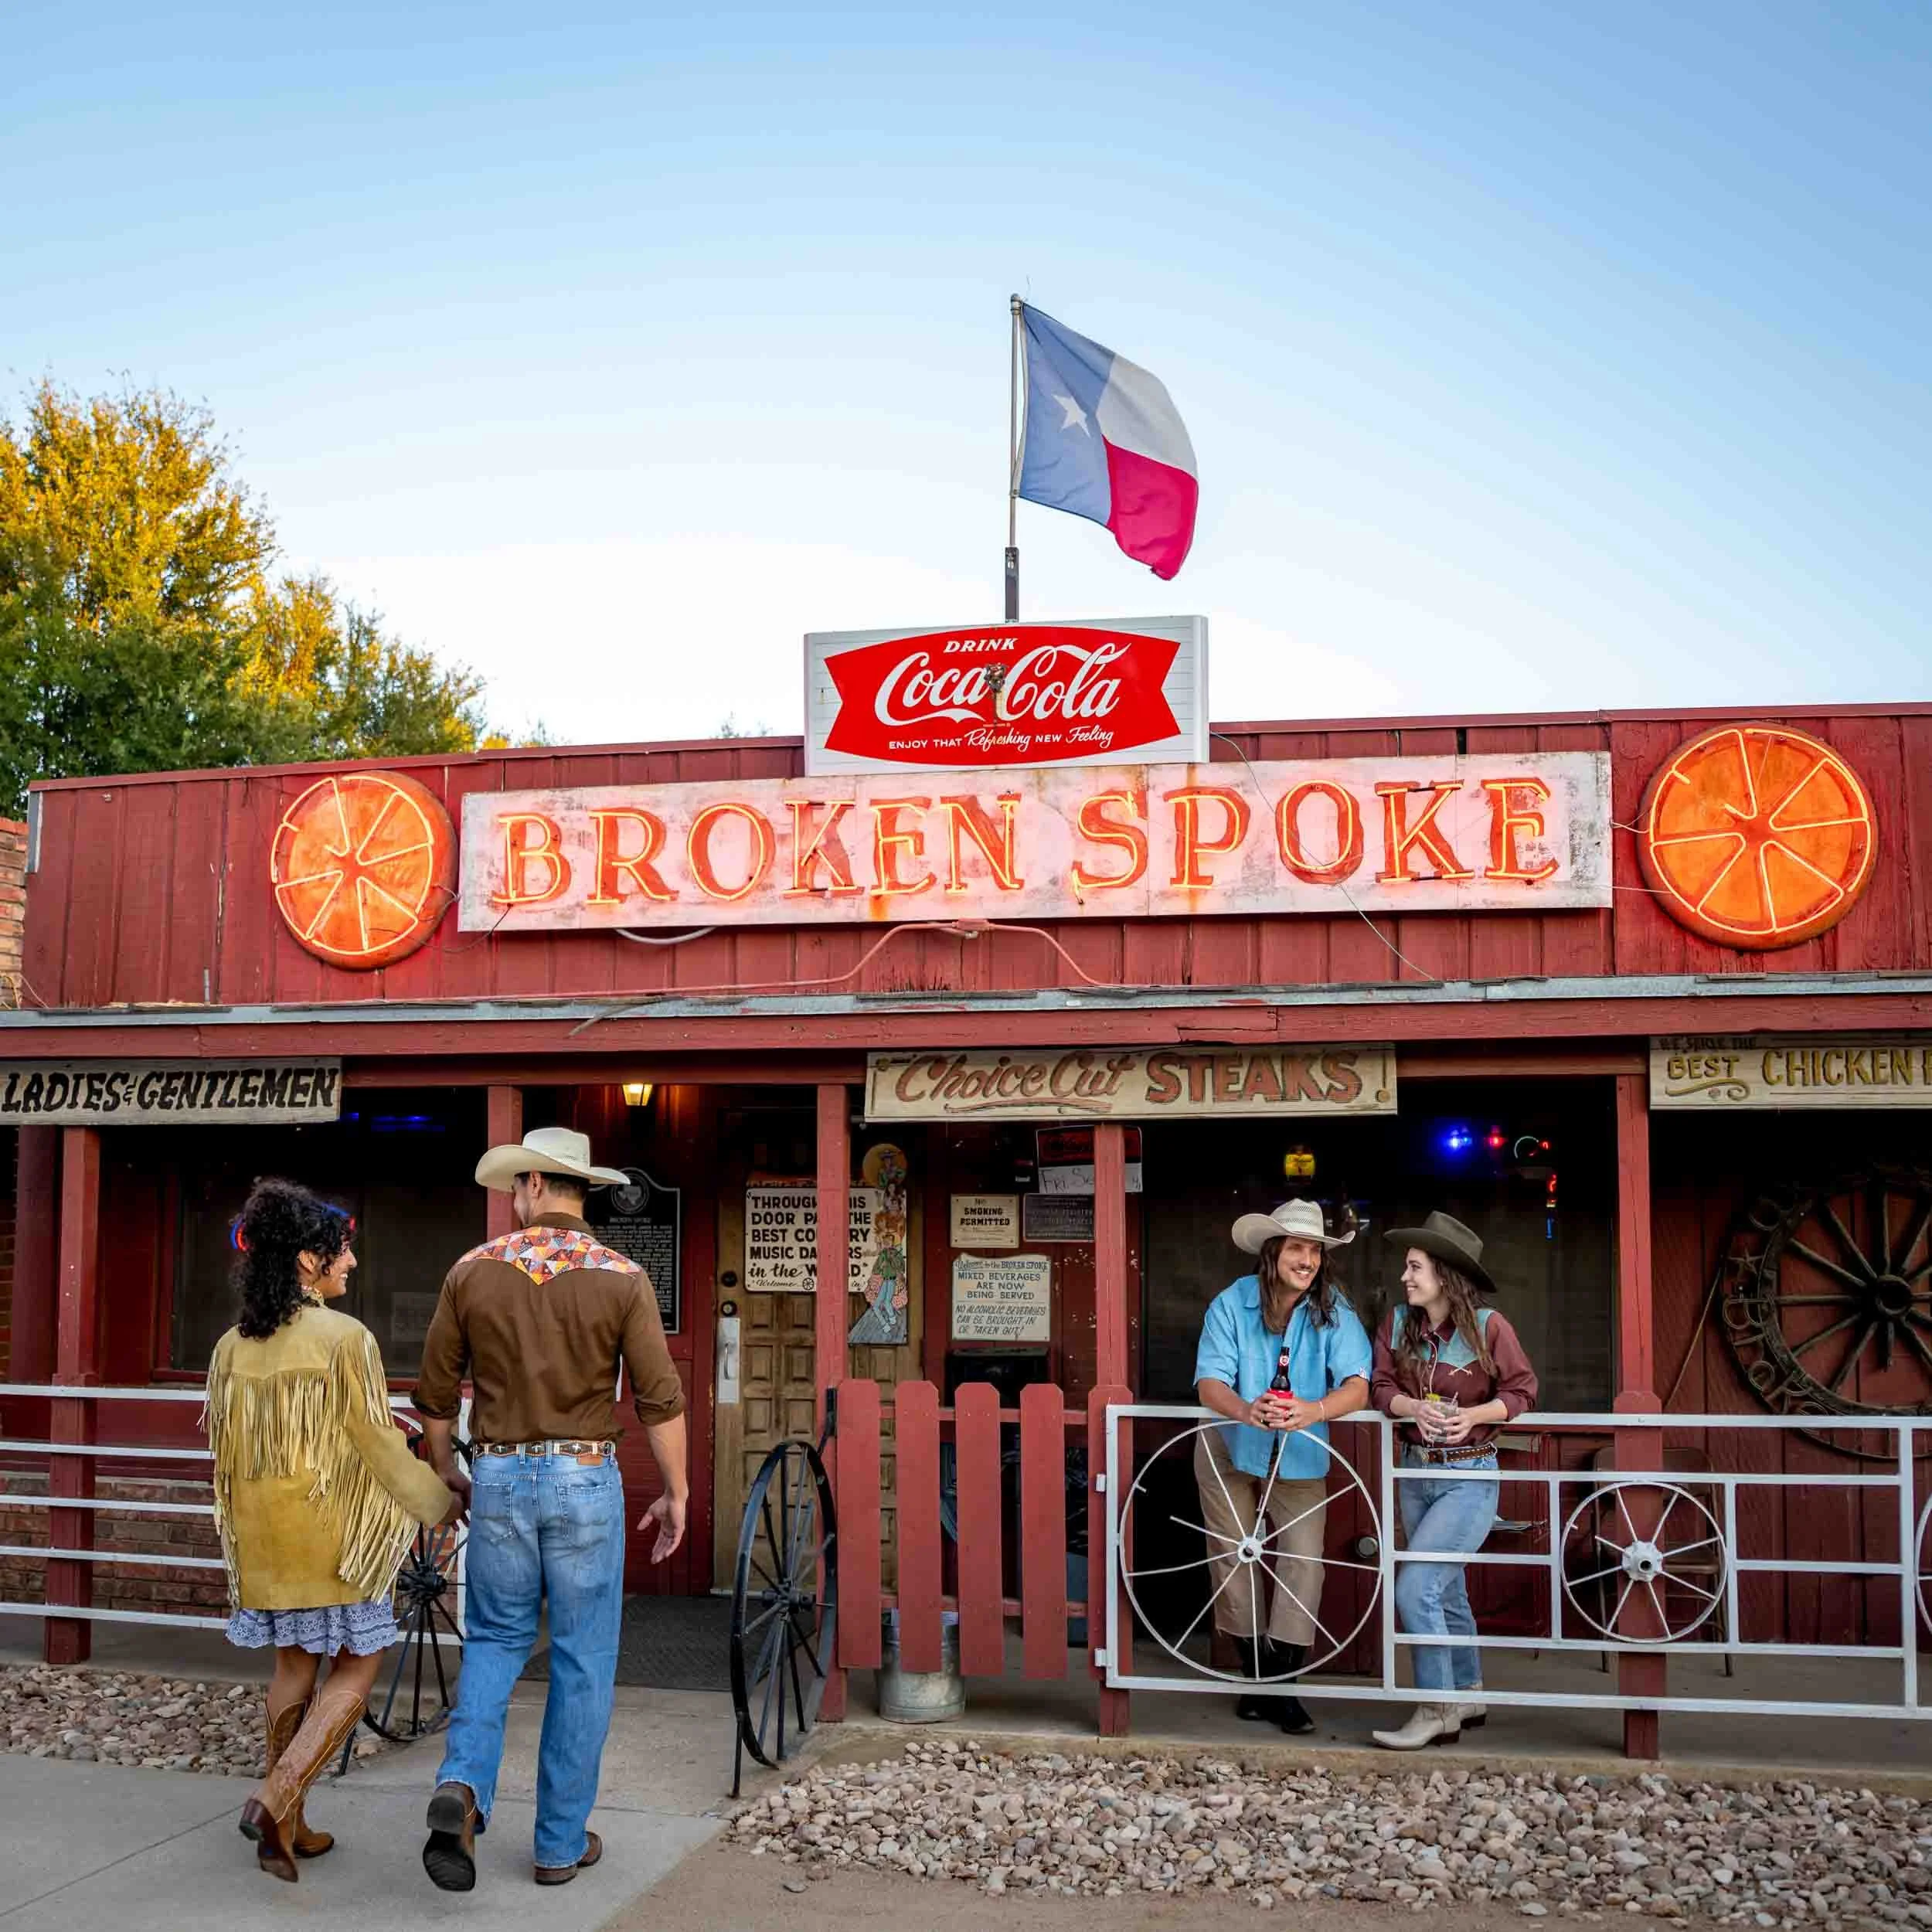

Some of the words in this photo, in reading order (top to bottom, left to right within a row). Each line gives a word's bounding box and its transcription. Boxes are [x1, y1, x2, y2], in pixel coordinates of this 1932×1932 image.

[943, 638, 1018, 654] DRINK
[874, 642, 1131, 726] CocaCola
[889, 740, 927, 749] ENJOY
[933, 738, 962, 747] THAT
[964, 727, 1031, 752] Refreshing
[1035, 734, 1062, 743] NEW
[1066, 725, 1114, 749] Feeling
[490, 793, 1024, 906] BROKEN
[1071, 777, 1560, 889] SPOKE
[1668, 1055, 1740, 1080] BEST
[1762, 1048, 1913, 1086] CHICKEN
[895, 1053, 1047, 1102] Choice
[1049, 1051, 1136, 1097] Cut
[1145, 1051, 1362, 1104] STEAKS
[2, 1072, 130, 1113] LADIES
[137, 1067, 338, 1111] GENTLEMEN
[751, 1212, 795, 1225] DOOR
[964, 1207, 1003, 1216] SMOKING
[960, 1217, 1010, 1226] PERMITTED
[751, 1229, 788, 1243] BEST
[794, 1228, 870, 1243] CORY
[750, 1246, 794, 1260] MUSIC
[799, 1246, 862, 1260] DARS
[748, 1263, 767, 1278] in
[771, 1263, 803, 1277] the
[958, 1272, 985, 1281] MIXED
[988, 1272, 1040, 1281] BEVERAGES
[967, 1304, 1005, 1314] ALCOHOLIC
[1005, 1306, 1046, 1315] BEVERAGES
[957, 1315, 971, 1324] CAN
[973, 1315, 984, 1325] BE
[986, 1315, 1024, 1325] BROUGHT
[974, 1325, 1000, 1335] TAKEN
